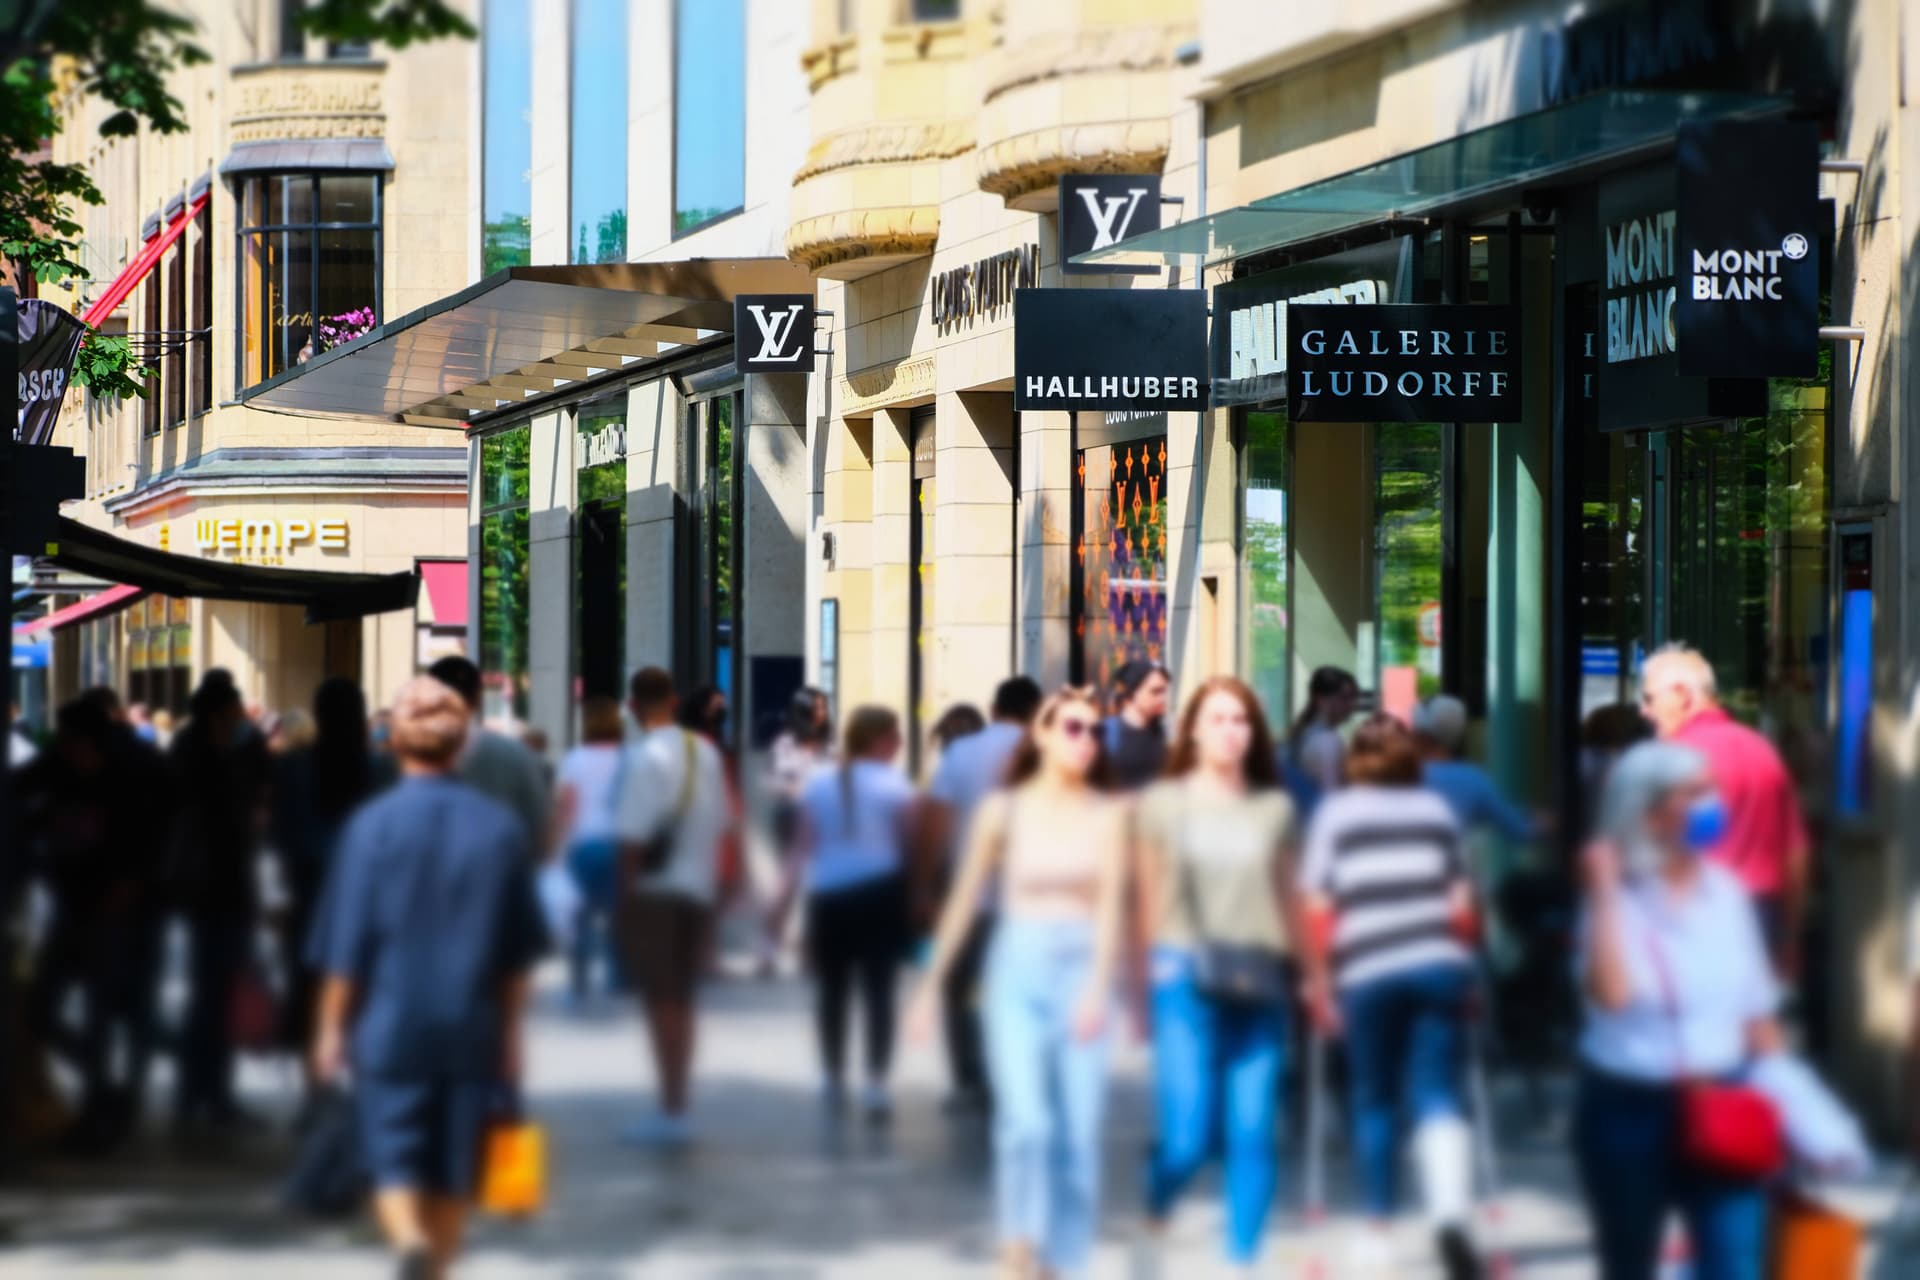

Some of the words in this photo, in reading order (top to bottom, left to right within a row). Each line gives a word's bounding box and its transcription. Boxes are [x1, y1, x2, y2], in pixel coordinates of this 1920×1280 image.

[1606, 210, 1677, 290] MONT
[1693, 249, 1783, 274] MONT
[931, 264, 971, 326] LOUIS
[1693, 275, 1783, 300] BLANC
[1607, 286, 1677, 364] BLANC
[1301, 330, 1509, 355] GALERIE
[1026, 376, 1198, 398] HALLHUBER
[1301, 371, 1509, 397] LUDORFF
[195, 519, 348, 551] WEMPE
